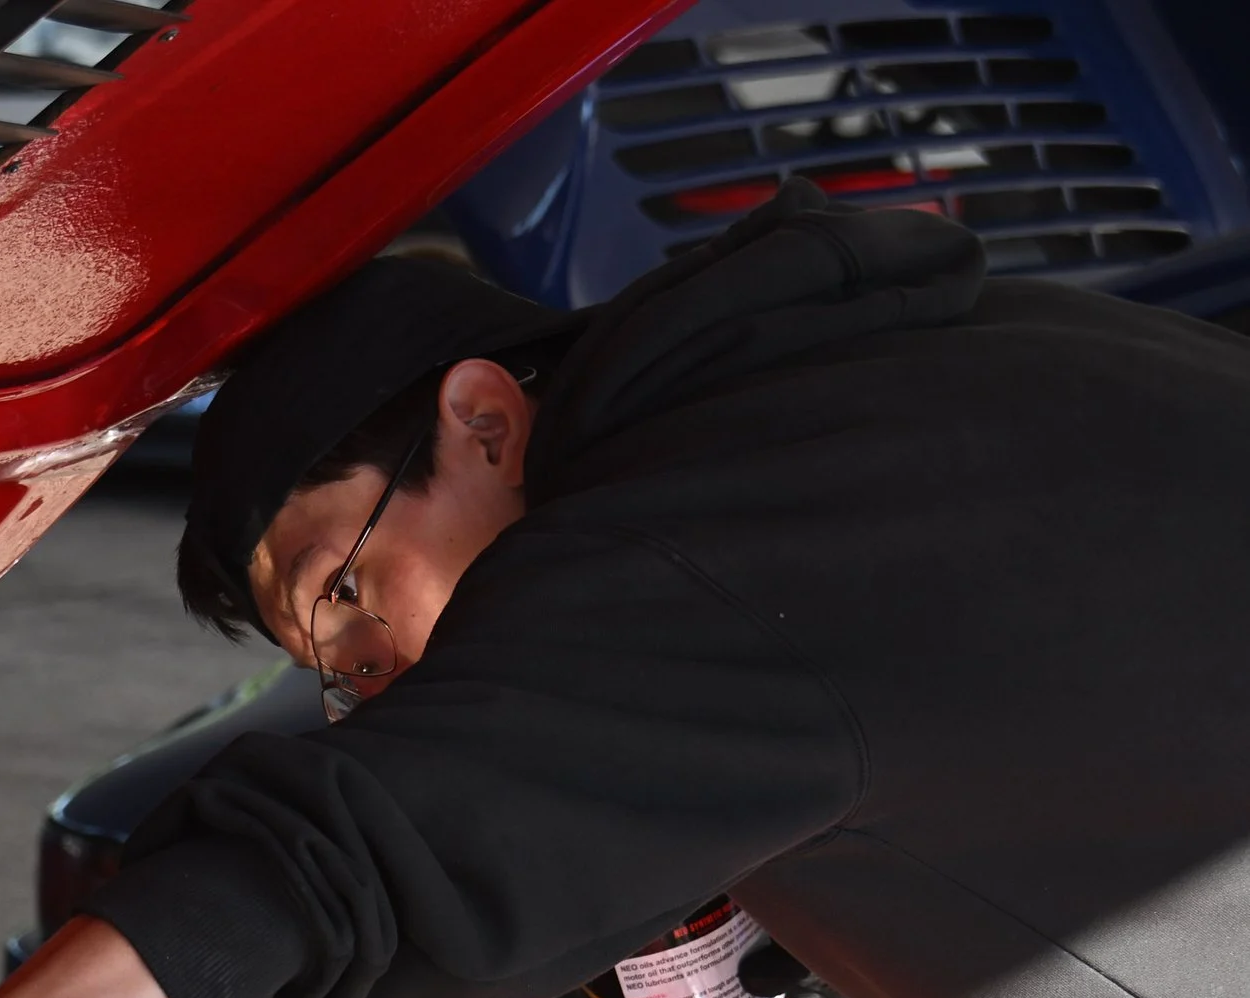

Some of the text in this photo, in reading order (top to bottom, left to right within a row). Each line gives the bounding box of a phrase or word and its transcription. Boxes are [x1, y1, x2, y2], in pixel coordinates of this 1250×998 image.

[620, 963, 638, 972] NEO
[656, 952, 688, 966] advance
[690, 931, 727, 953] formulation
[624, 973, 645, 981] motor
[659, 965, 675, 974] that
[676, 947, 721, 970] outperforms
[626, 982, 644, 990] NEO
[645, 972, 684, 988] lubricants
[687, 968, 699, 977] are
[700, 949, 734, 971] formulated
